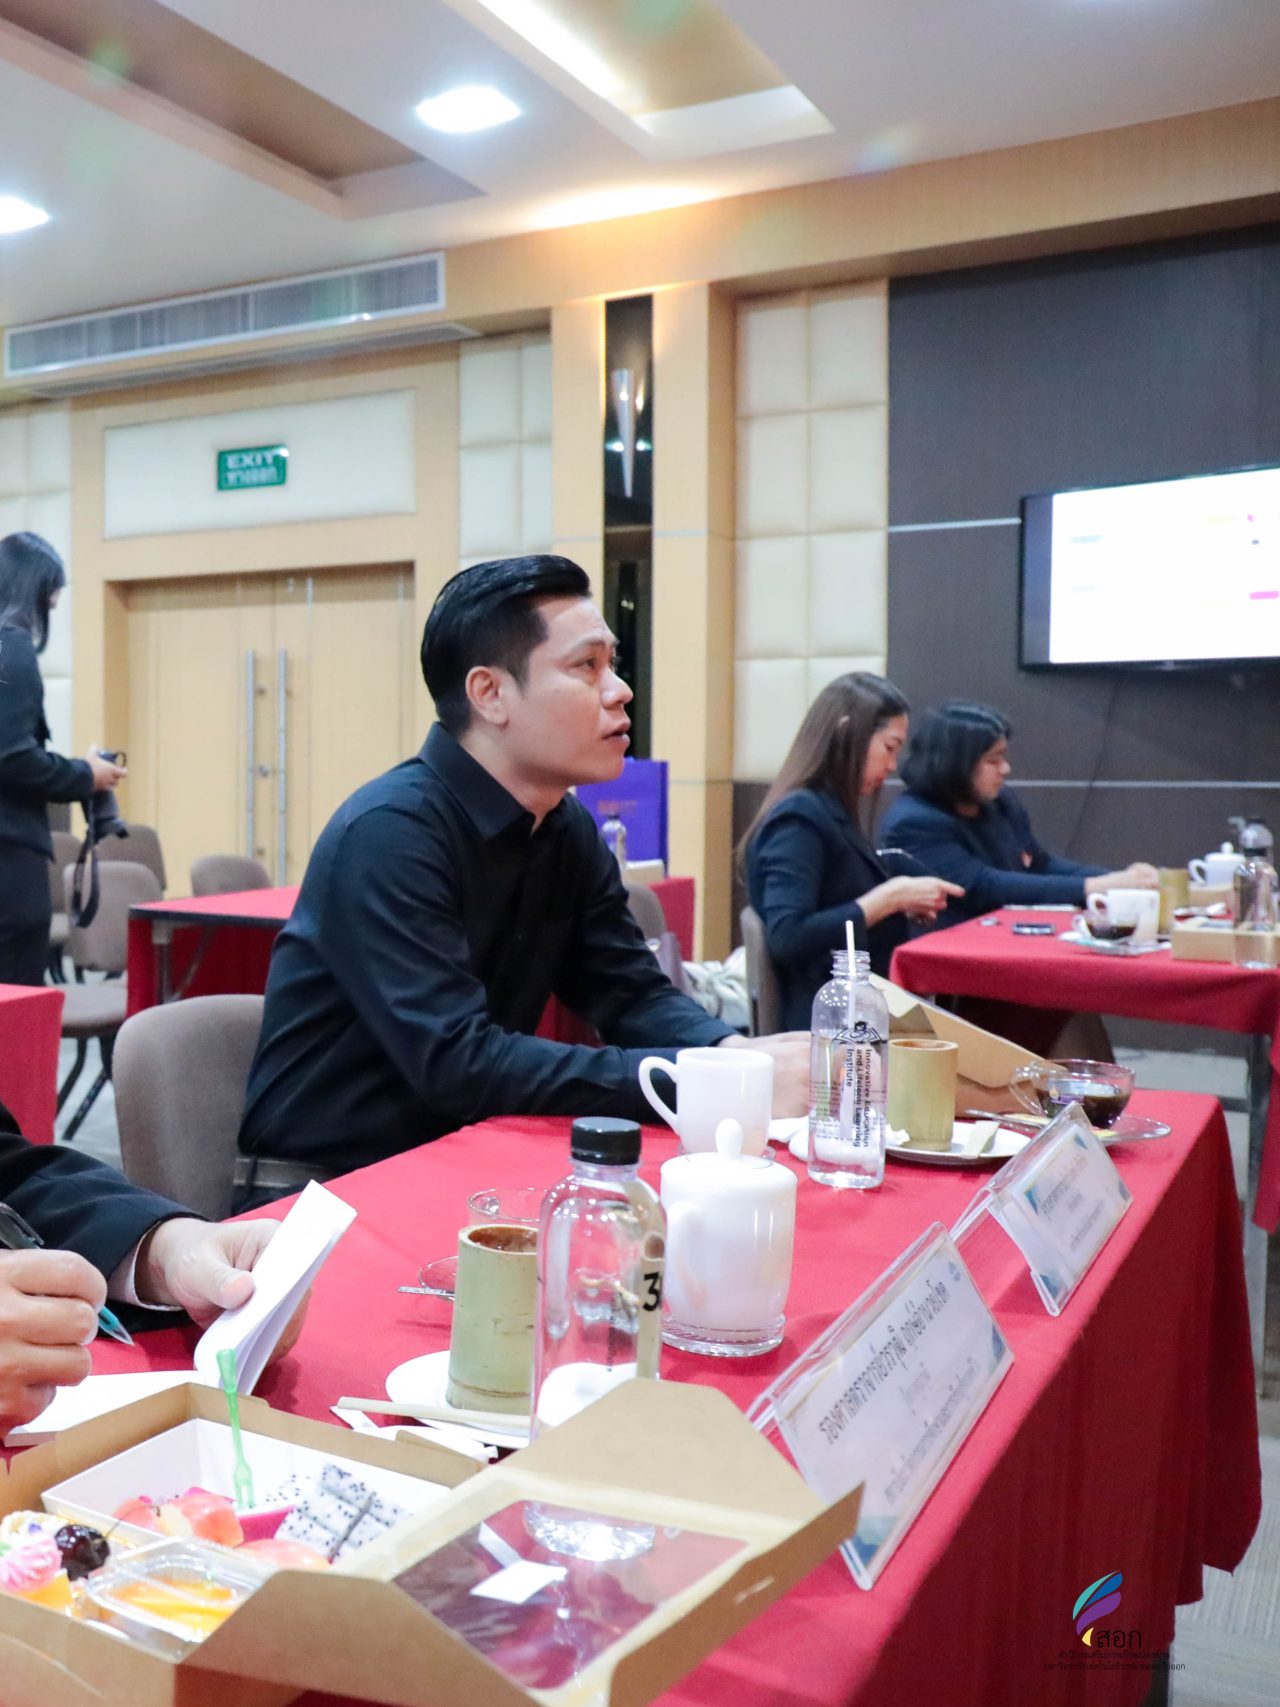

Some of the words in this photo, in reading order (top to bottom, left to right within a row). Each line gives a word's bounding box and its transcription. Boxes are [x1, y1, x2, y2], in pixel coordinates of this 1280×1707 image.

[227, 451, 277, 468] EXIT
[846, 1048, 854, 1087] Institute
[855, 1068, 864, 1105] Lifelong
[864, 1049, 872, 1097] Innovative
[852, 1107, 863, 1147] Learning
[863, 1100, 871, 1147] Education
